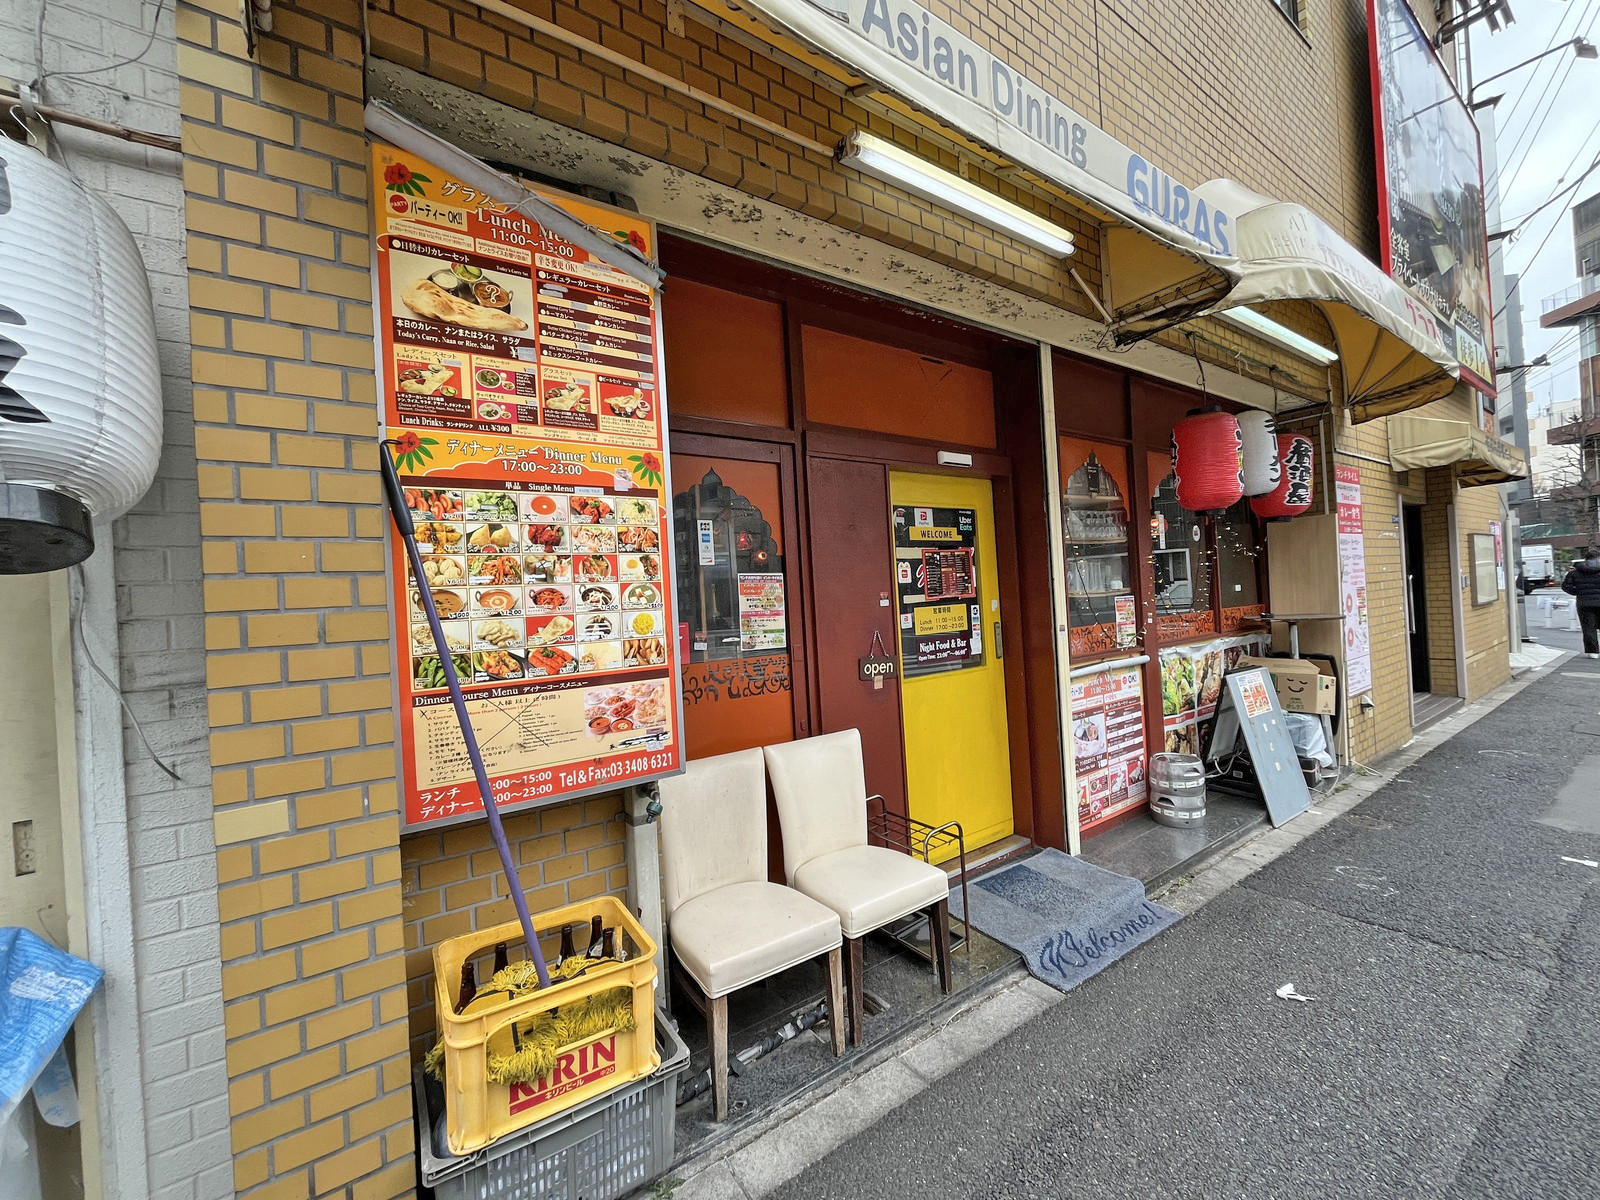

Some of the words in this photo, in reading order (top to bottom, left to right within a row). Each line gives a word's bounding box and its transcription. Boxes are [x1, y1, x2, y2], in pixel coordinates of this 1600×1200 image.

[862, 0, 979, 98] Asian
[992, 60, 1087, 169] Dining
[410, 201, 446, 221] パーティー
[1127, 154, 1231, 256] GURAS
[477, 205, 531, 235] Lunch
[401, 241, 470, 263] 日替わりカレーセット
[546, 272, 611, 294] レギュラーカレーセット
[397, 329, 421, 340] Today's
[442, 336, 457, 345] Naan
[480, 342, 495, 351] Salad
[403, 347, 457, 360] レディースセット
[401, 415, 423, 425] Lunch
[424, 416, 444, 427] Drinks:
[491, 424, 510, 433] ¥300
[446, 439, 539, 458] ディナーメニュー
[544, 447, 587, 462] Dinner
[590, 451, 623, 465] Menu
[1264, 418, 1281, 483] ラーメン
[1283, 438, 1313, 506] 居酒屋
[505, 481, 522, 490] 単品
[528, 482, 552, 493] Single
[553, 484, 575, 493] Menu
[959, 516, 972, 524] Uber
[920, 530, 953, 539] WELCOME
[933, 606, 952, 615] 営業時間
[919, 641, 936, 654] Night
[936, 639, 951, 650] Food
[951, 638, 956, 648] &
[957, 637, 967, 647] Bar
[864, 660, 894, 677] open
[415, 695, 452, 706] Dinner
[461, 692, 489, 701] ourse
[492, 687, 519, 698] Menu
[523, 681, 589, 694] ディナーコースメニュー
[420, 787, 461, 806] ランチ
[420, 801, 474, 819] ディナー
[479, 784, 553, 806] 1:00〜23:00
[545, 1078, 585, 1100] キリンビール
